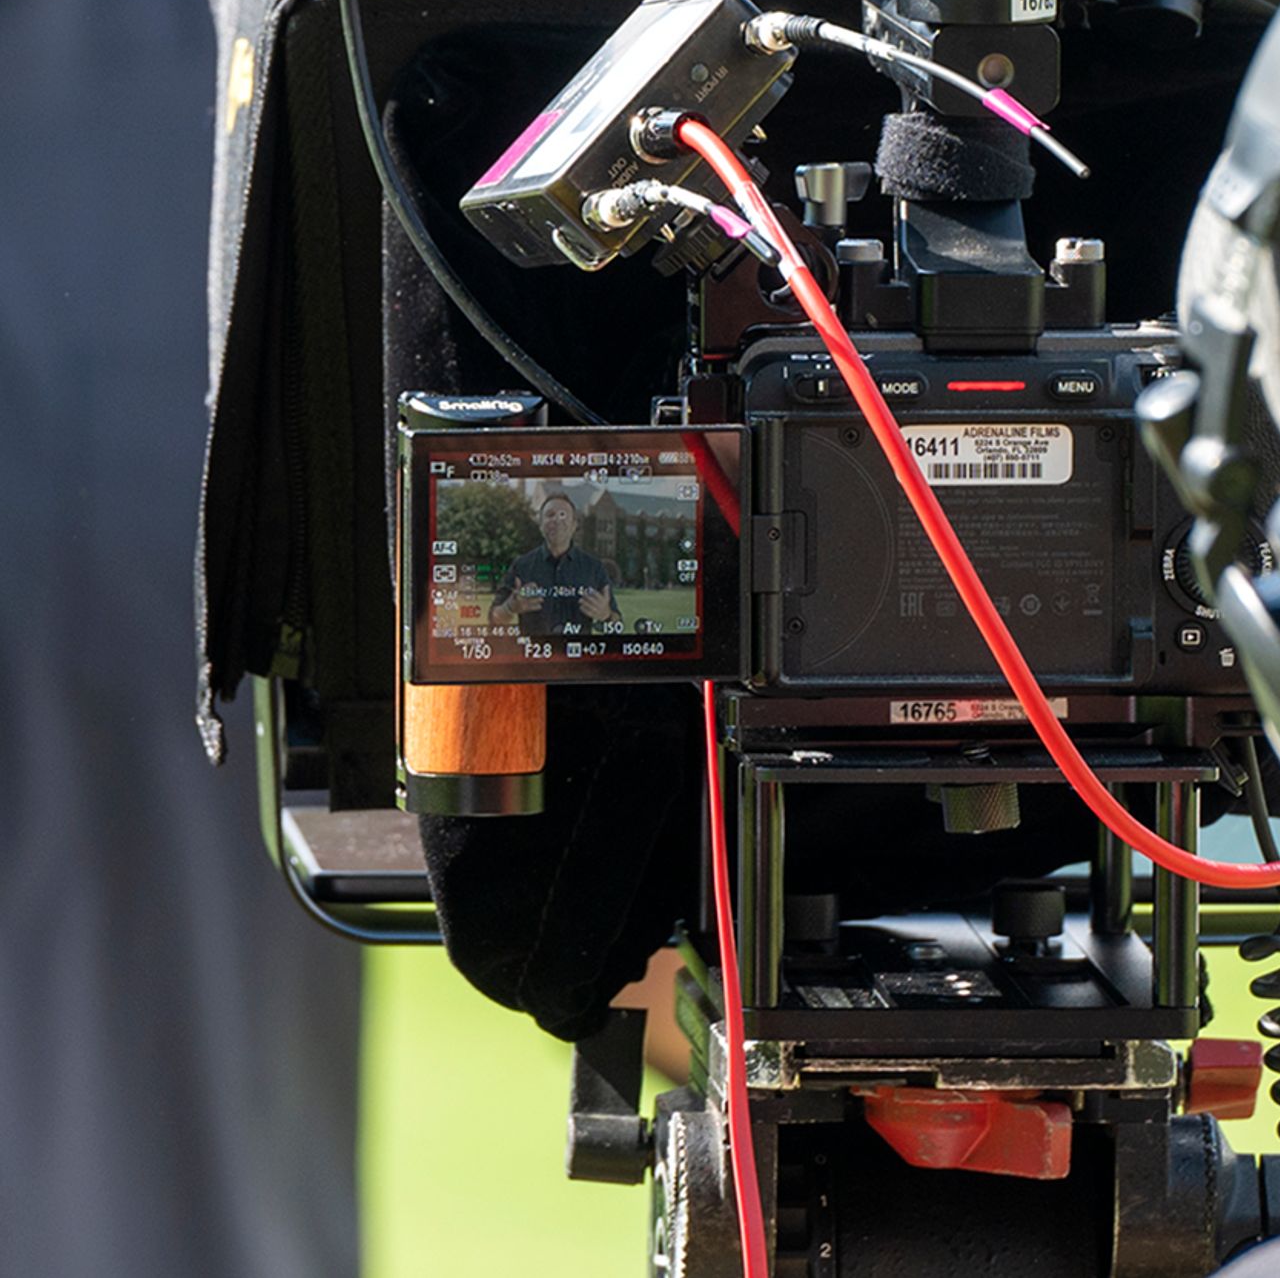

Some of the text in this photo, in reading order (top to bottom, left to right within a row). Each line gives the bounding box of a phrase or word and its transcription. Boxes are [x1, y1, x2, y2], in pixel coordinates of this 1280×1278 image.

[695, 74, 721, 104] PORT
[608, 157, 627, 178] OUT
[882, 382, 919, 394] MODE
[1058, 381, 1095, 393] MENU
[963, 427, 1061, 438] ADRENALINE FILMS
[1003, 439, 1032, 448] Orange
[434, 542, 455, 553] AF-C
[1163, 548, 1175, 581] ZEBRA
[679, 572, 696, 583] OFF
[563, 621, 662, 635] Av ISO Tv
[461, 643, 492, 659] 1/50
[524, 643, 553, 658] F2.8
[583, 642, 606, 655] +0.7
[899, 702, 957, 721] 16765
[820, 1194, 828, 1208] 1
[820, 1242, 832, 1258] 2
